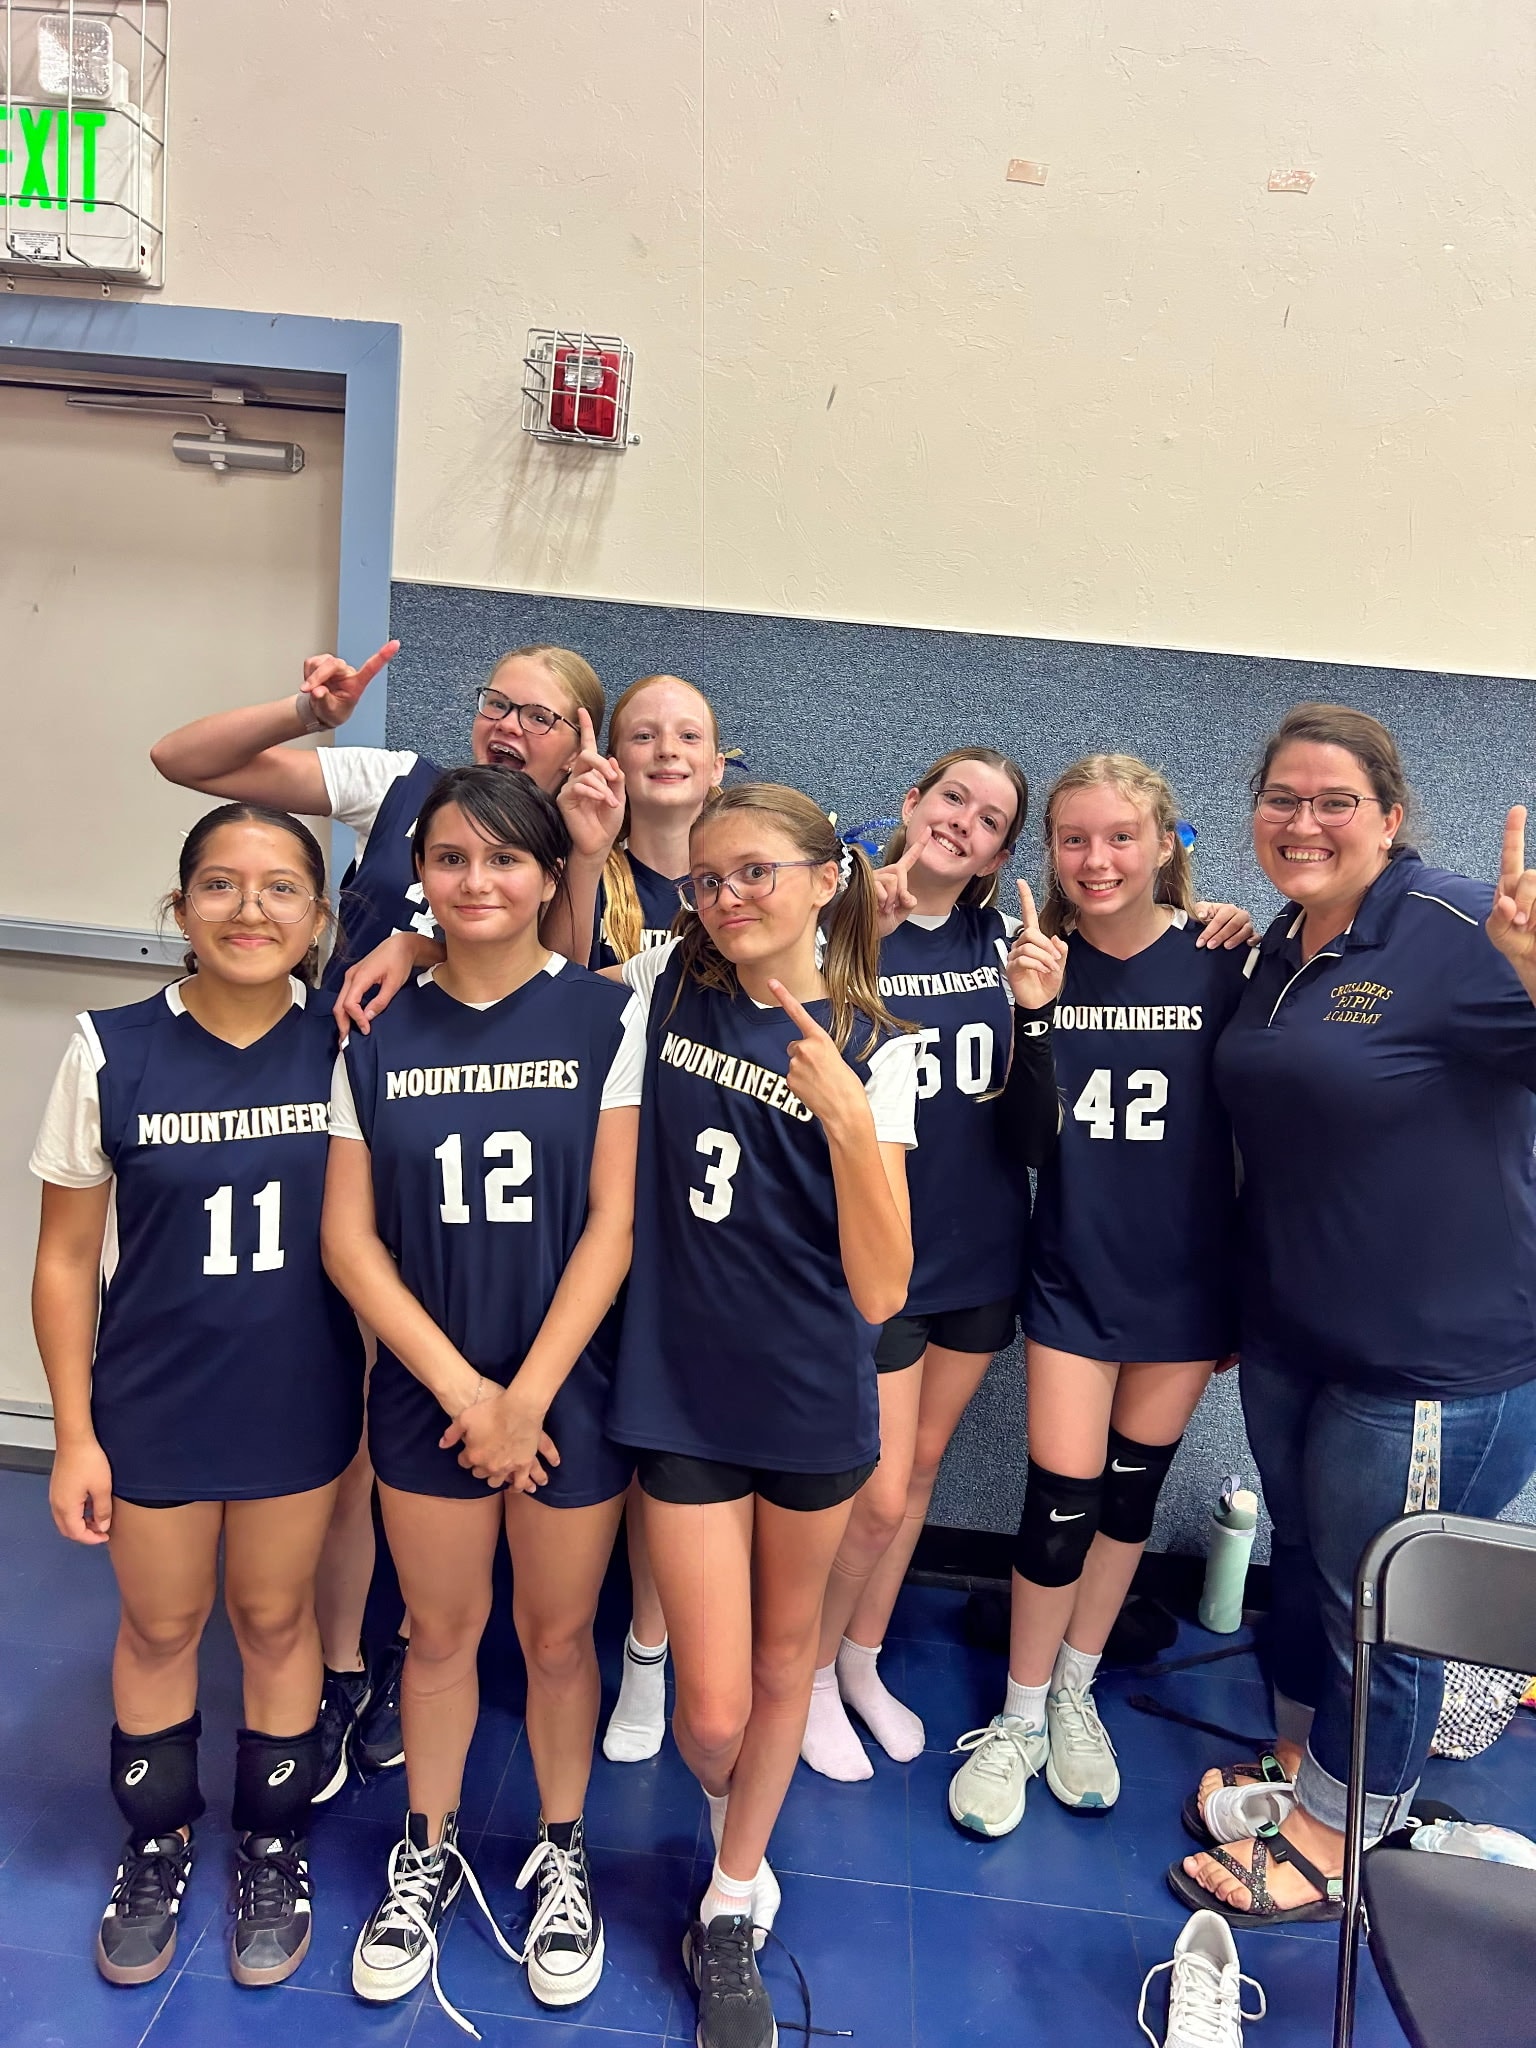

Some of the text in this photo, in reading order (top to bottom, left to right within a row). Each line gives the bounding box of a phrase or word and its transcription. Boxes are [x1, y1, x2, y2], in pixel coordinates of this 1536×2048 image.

[876, 966, 1000, 997] OUNTAINEERS
[1323, 1010, 1383, 1025] ACADEMY
[1330, 981, 1394, 1001] CRUSADERS
[386, 1059, 580, 1101] MOUNTAINEERS
[916, 1022, 994, 1100] 50
[1072, 1068, 1169, 1141] 42
[434, 1130, 533, 1224] 12
[688, 1127, 742, 1224] 3
[203, 1180, 285, 1276] 11
